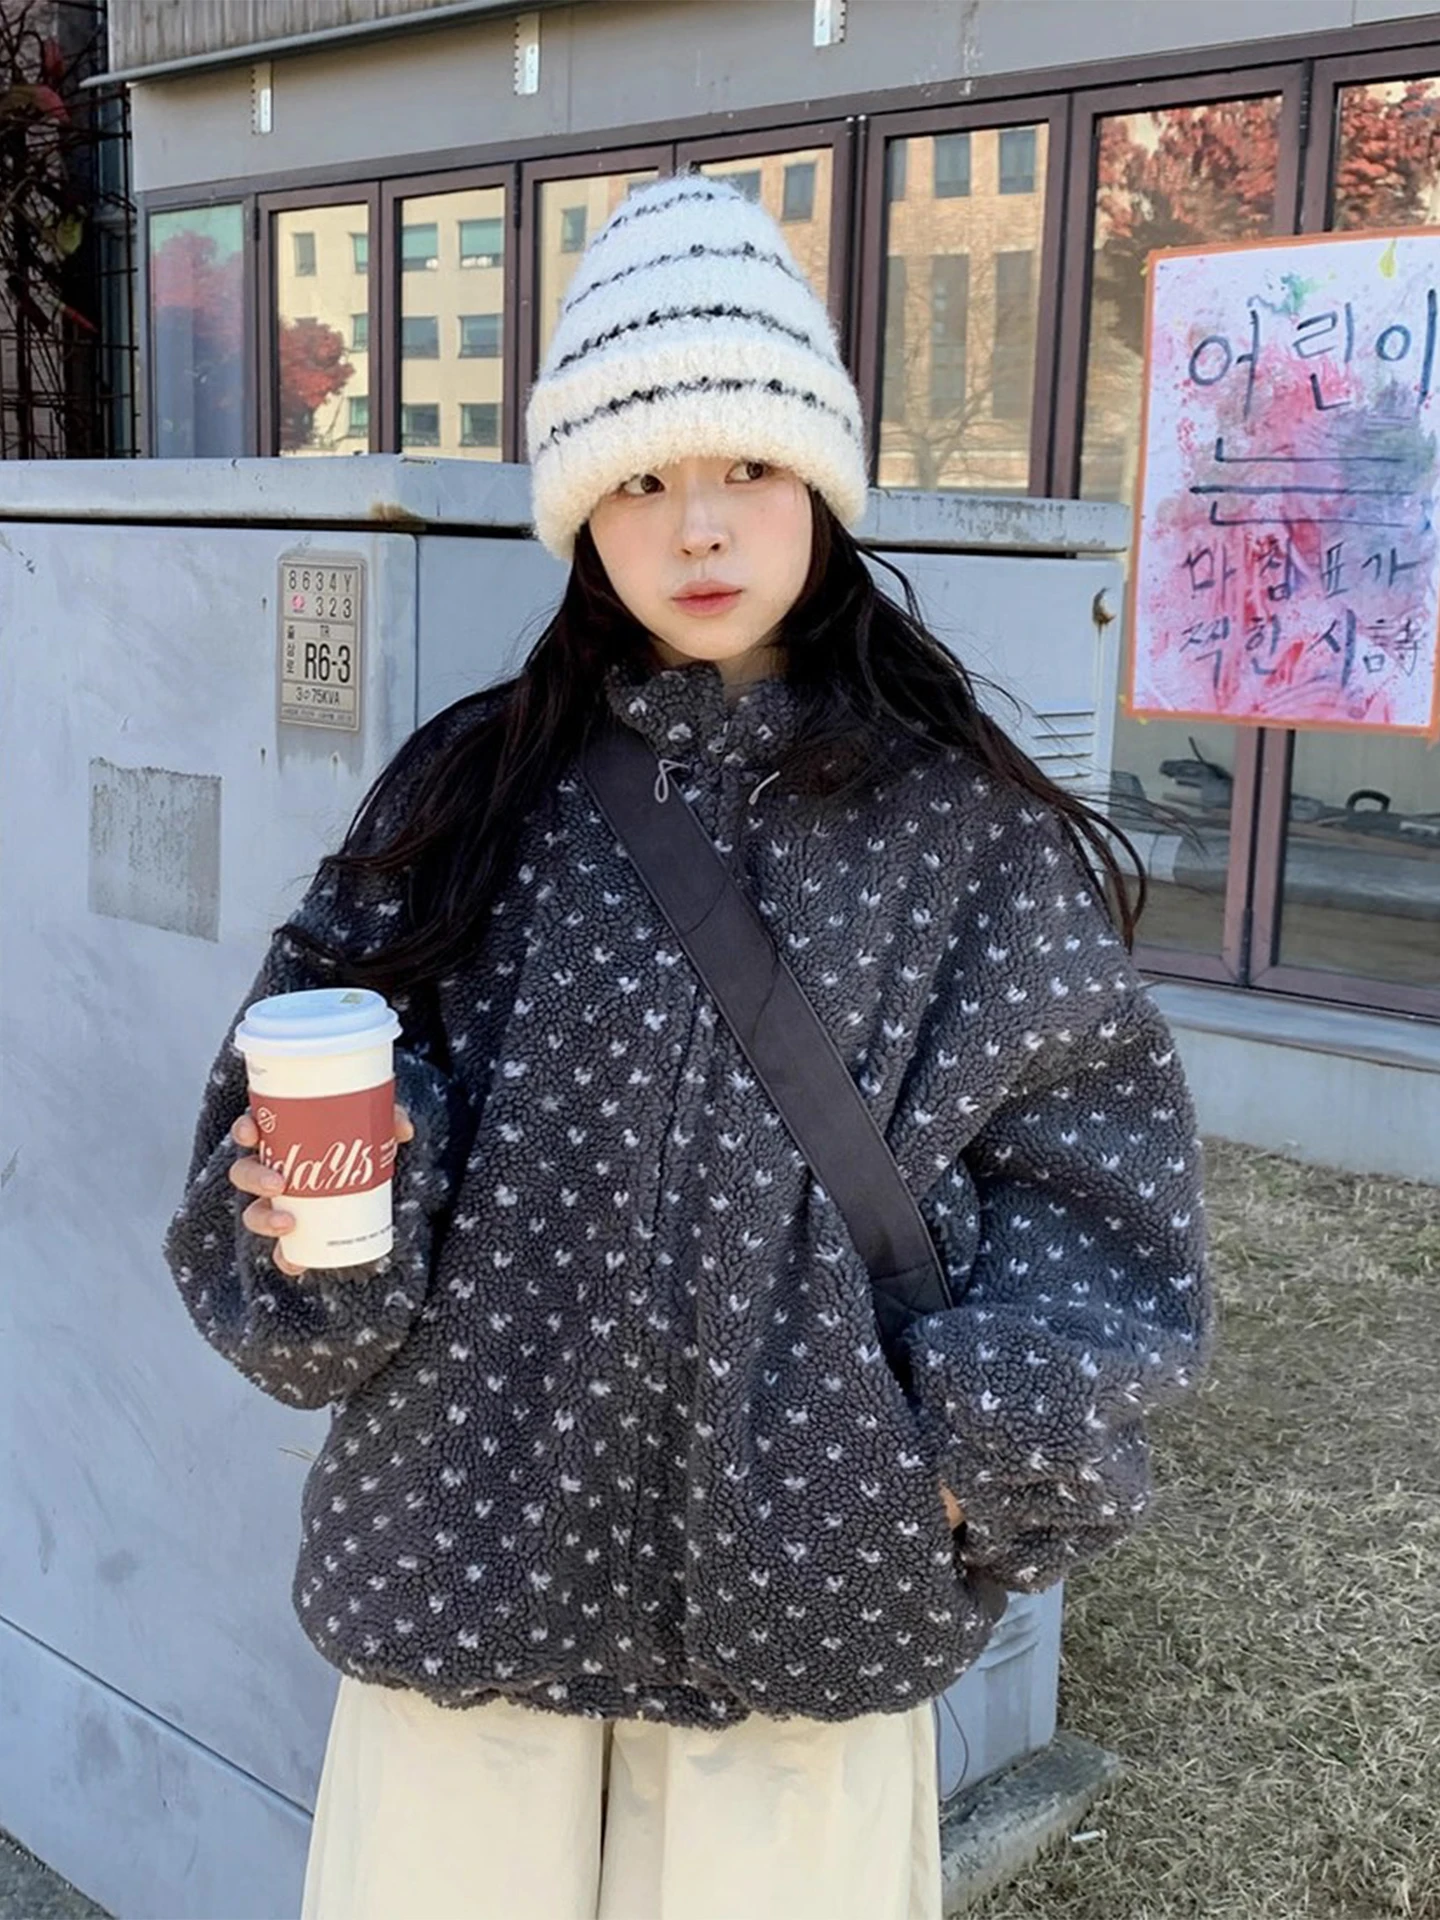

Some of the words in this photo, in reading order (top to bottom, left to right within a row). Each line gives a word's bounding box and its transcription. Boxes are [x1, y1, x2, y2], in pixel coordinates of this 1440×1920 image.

[1188, 289, 1437, 420] 어린이
[1189, 437, 1416, 528] 는
[315, 595, 352, 619] 323
[1181, 535, 1421, 607] 마침표가
[304, 642, 351, 684] R6-3
